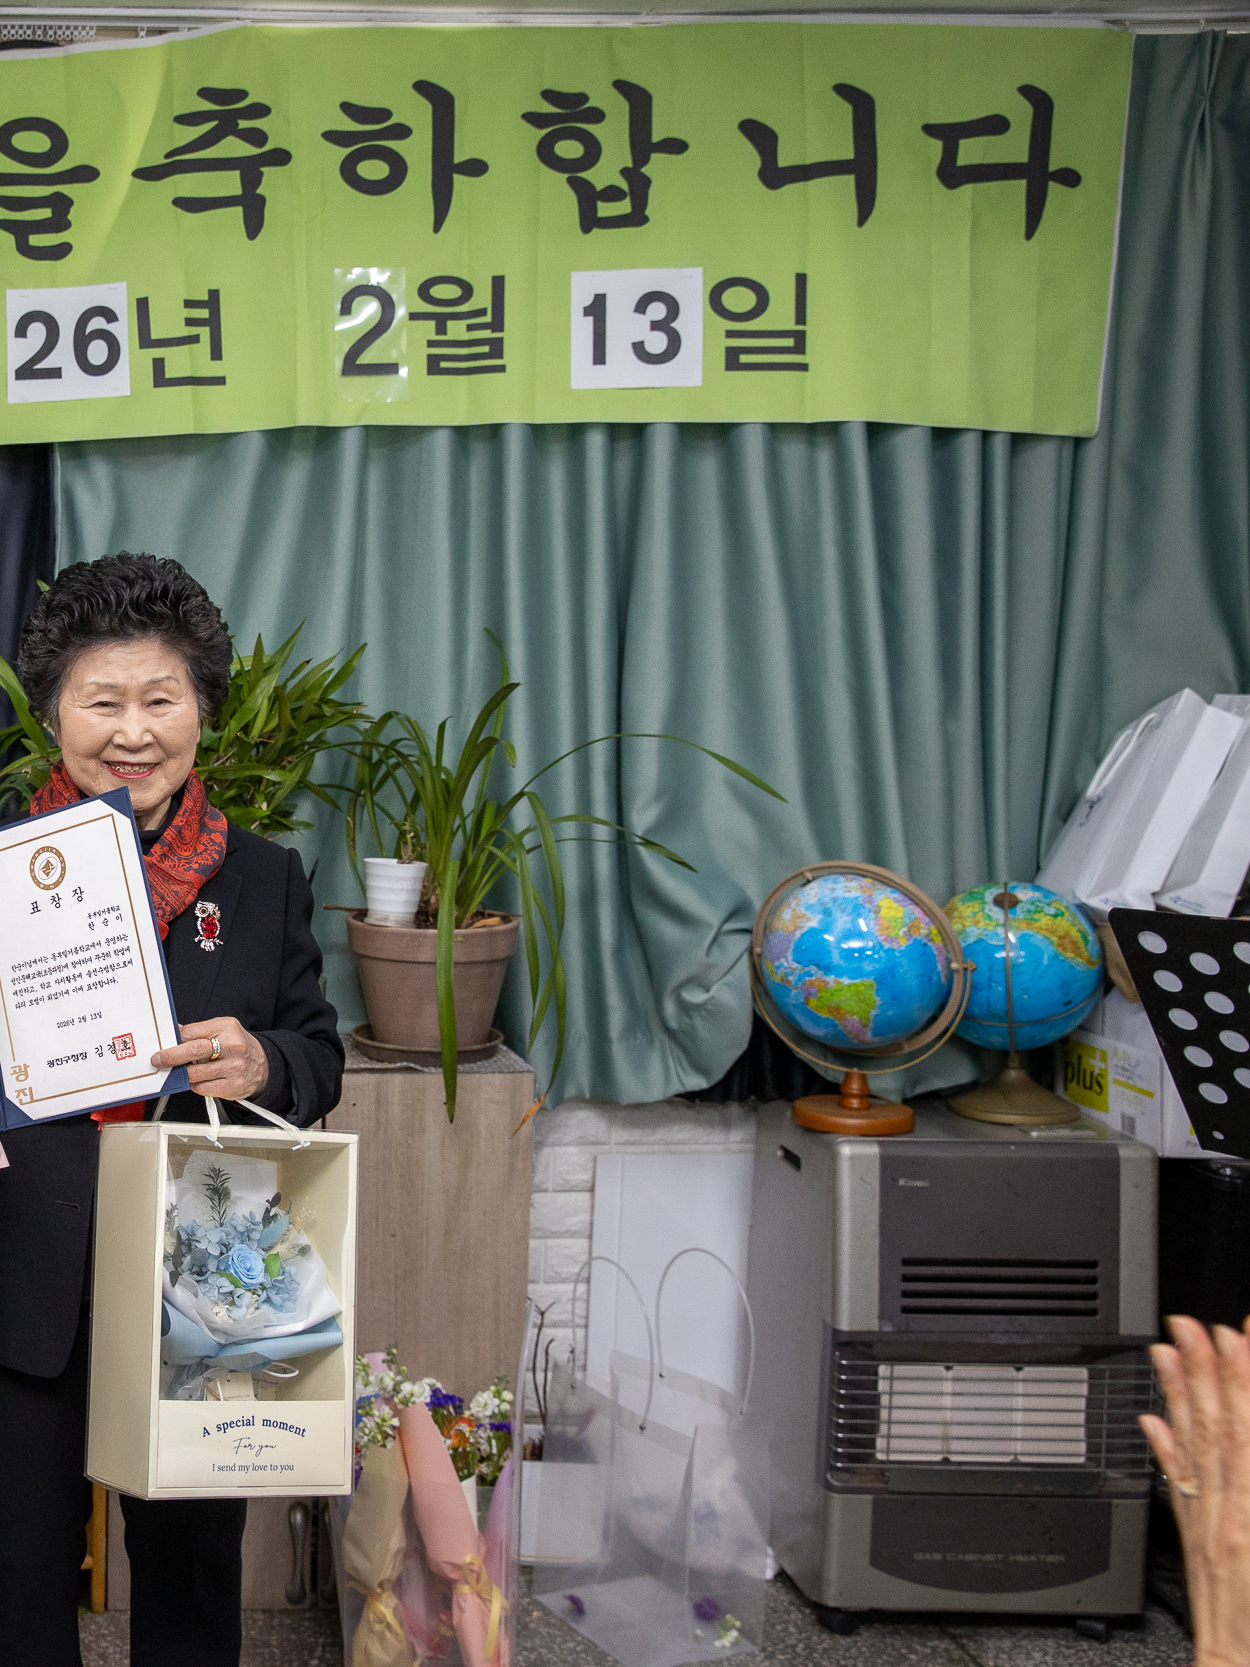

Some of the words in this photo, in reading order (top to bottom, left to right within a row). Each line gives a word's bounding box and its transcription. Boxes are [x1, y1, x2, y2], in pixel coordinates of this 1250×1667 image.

[339, 275, 507, 378] 2월
[583, 272, 809, 372] 13일
[104, 933, 129, 947] 운영하는
[113, 945, 131, 956] 학업에
[40, 981, 52, 990] 학교
[72, 984, 84, 994] 이에
[77, 1014, 88, 1024] 2월
[90, 1010, 103, 1021] 13일
[46, 1051, 88, 1069] 광진구청장
[1063, 1054, 1106, 1096] plus
[202, 1426, 212, 1438] A
[216, 1415, 256, 1434] special
[261, 1418, 307, 1438] moment
[232, 1437, 256, 1455] For
[255, 1443, 277, 1458] you
[212, 1463, 216, 1472] I
[217, 1462, 236, 1472] send
[238, 1465, 251, 1474] my
[252, 1462, 268, 1472] love
[269, 1463, 278, 1472] to
[280, 1465, 294, 1474] you
